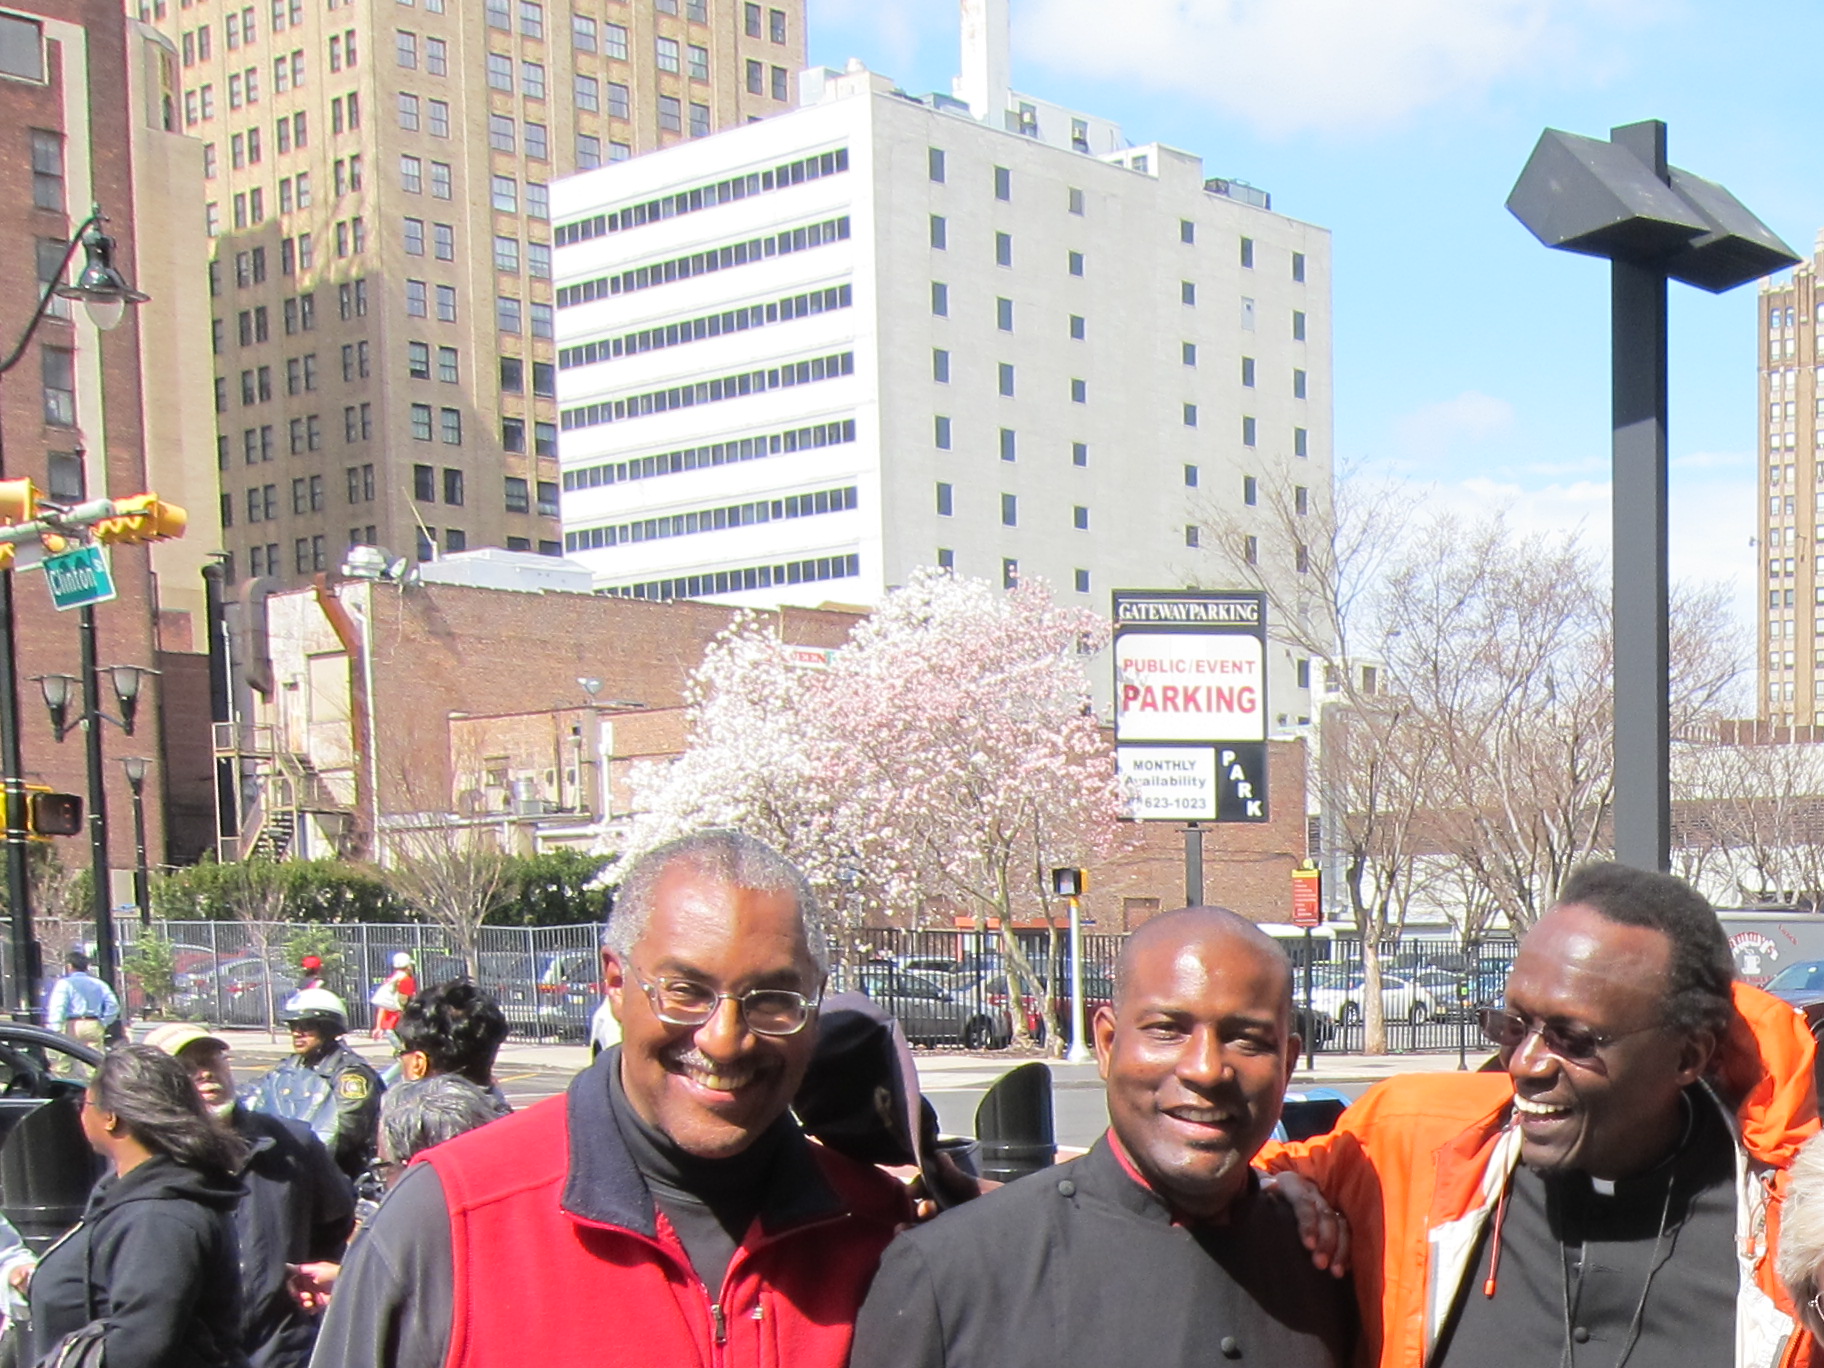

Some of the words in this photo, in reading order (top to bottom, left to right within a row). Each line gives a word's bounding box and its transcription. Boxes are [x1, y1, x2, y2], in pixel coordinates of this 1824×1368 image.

[49, 567, 97, 596] Clinton
[1123, 684, 1257, 714] PARKING
[1133, 760, 1196, 771] MONTHLY
